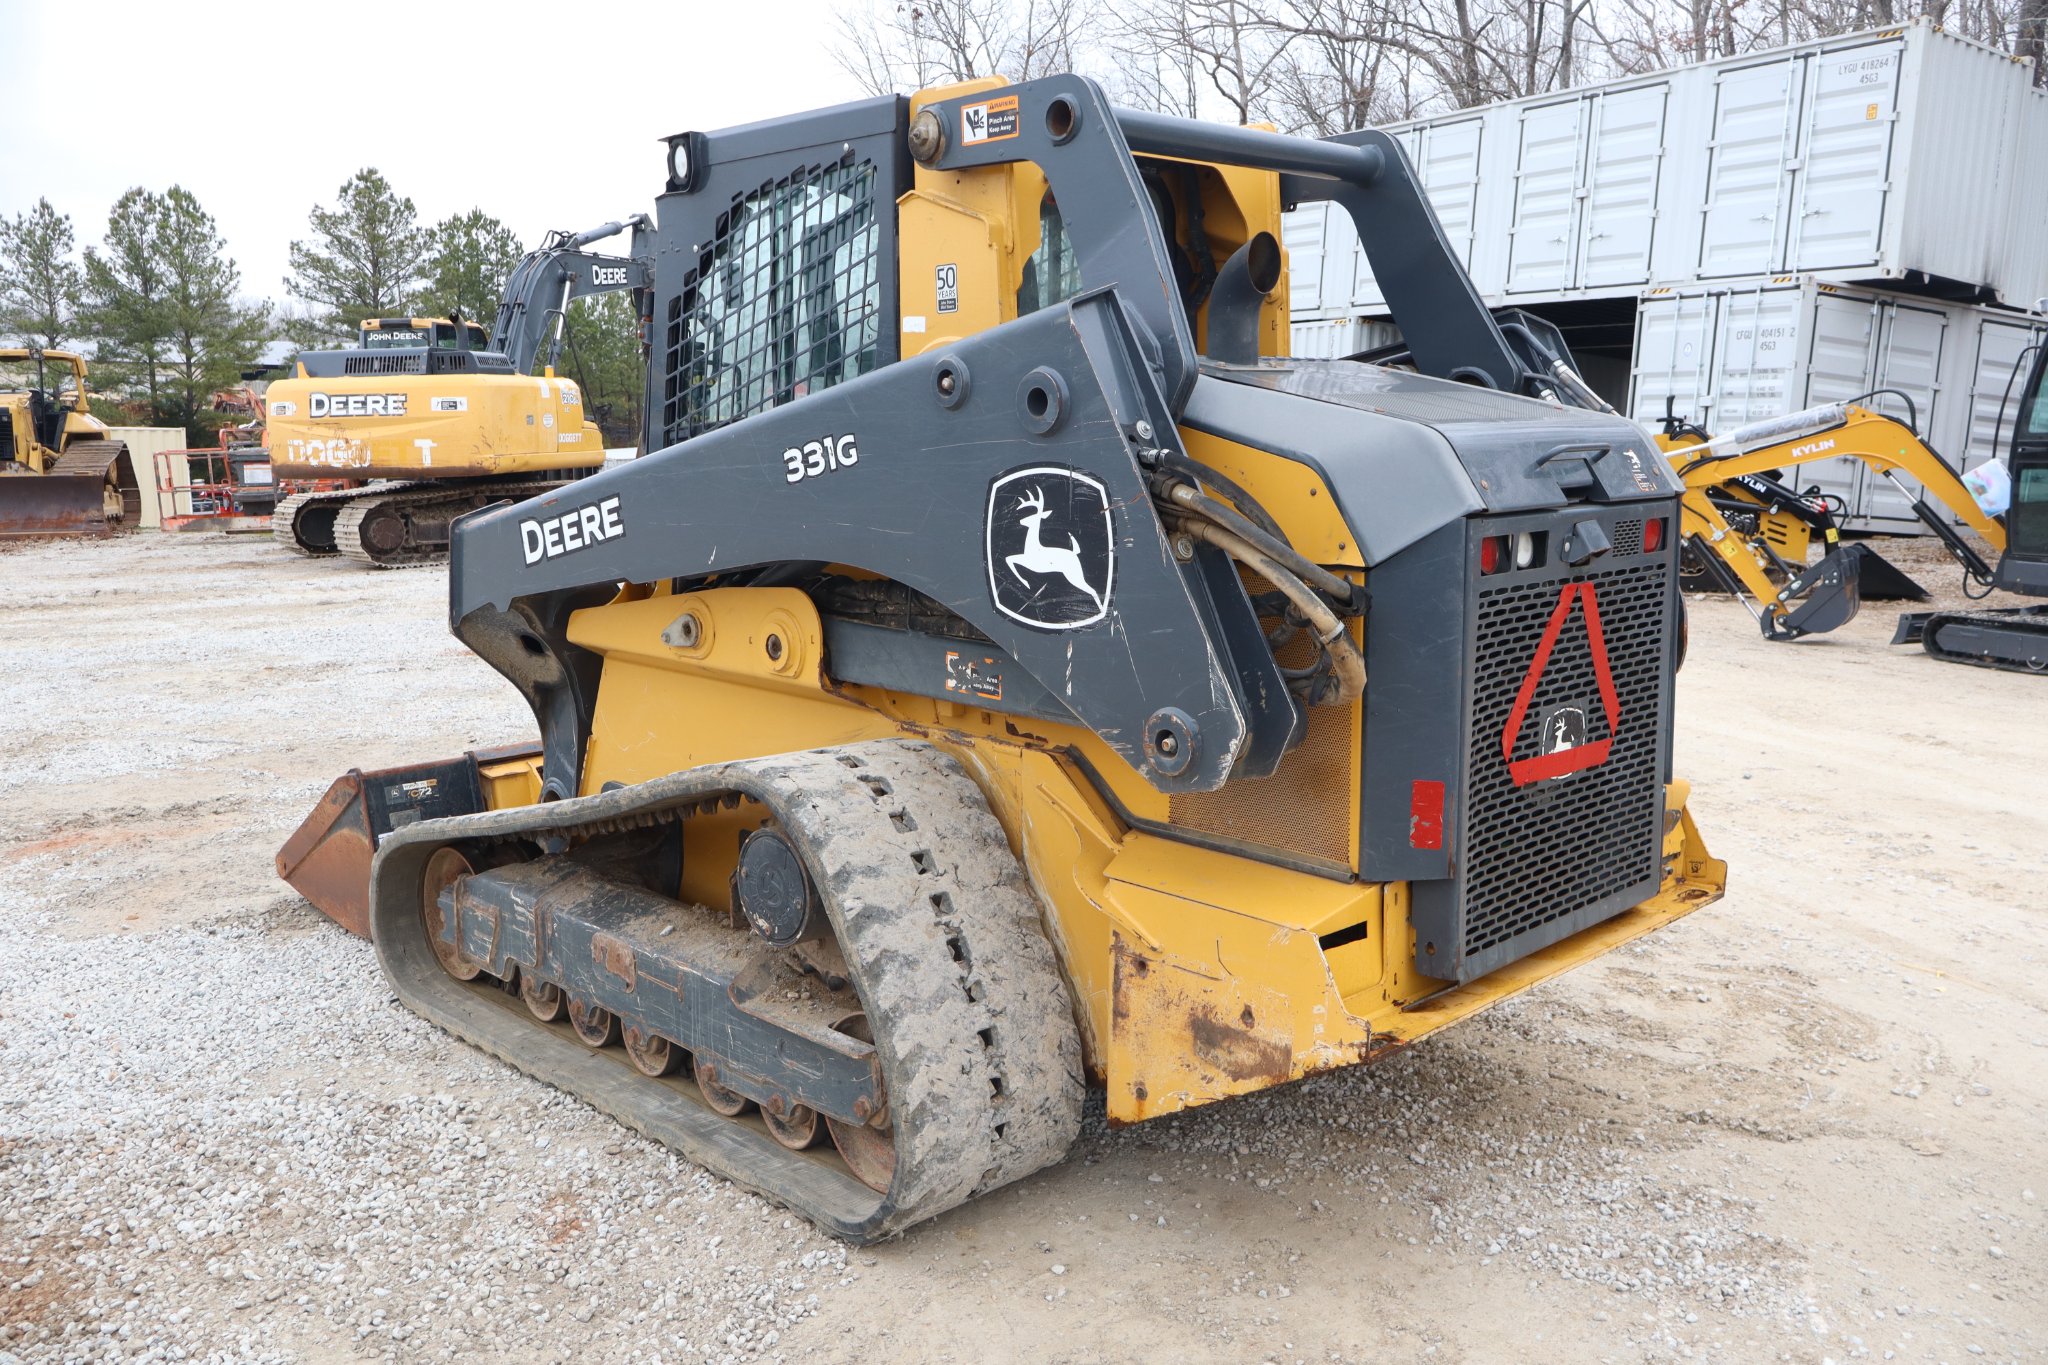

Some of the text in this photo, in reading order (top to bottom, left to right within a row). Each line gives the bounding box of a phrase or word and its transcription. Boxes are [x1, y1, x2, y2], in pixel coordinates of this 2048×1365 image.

[1839, 63, 1858, 75] LYGU
[1860, 57, 1889, 71] 418264
[1859, 72, 1879, 84] 45G3
[989, 116, 1003, 125] Pinch
[592, 265, 628, 285] DEERE
[937, 267, 955, 290] 50
[937, 289, 956, 298] YEARS
[367, 332, 392, 341] JOHN
[1736, 327, 1796, 340] CFGU 404151 2
[1760, 341, 1776, 351] 45G3
[311, 392, 406, 417] DEERE
[558, 433, 582, 442] DOGGETT
[1791, 439, 1835, 458] KYLIN
[783, 434, 859, 483] 331G
[520, 497, 624, 565] DEERE
